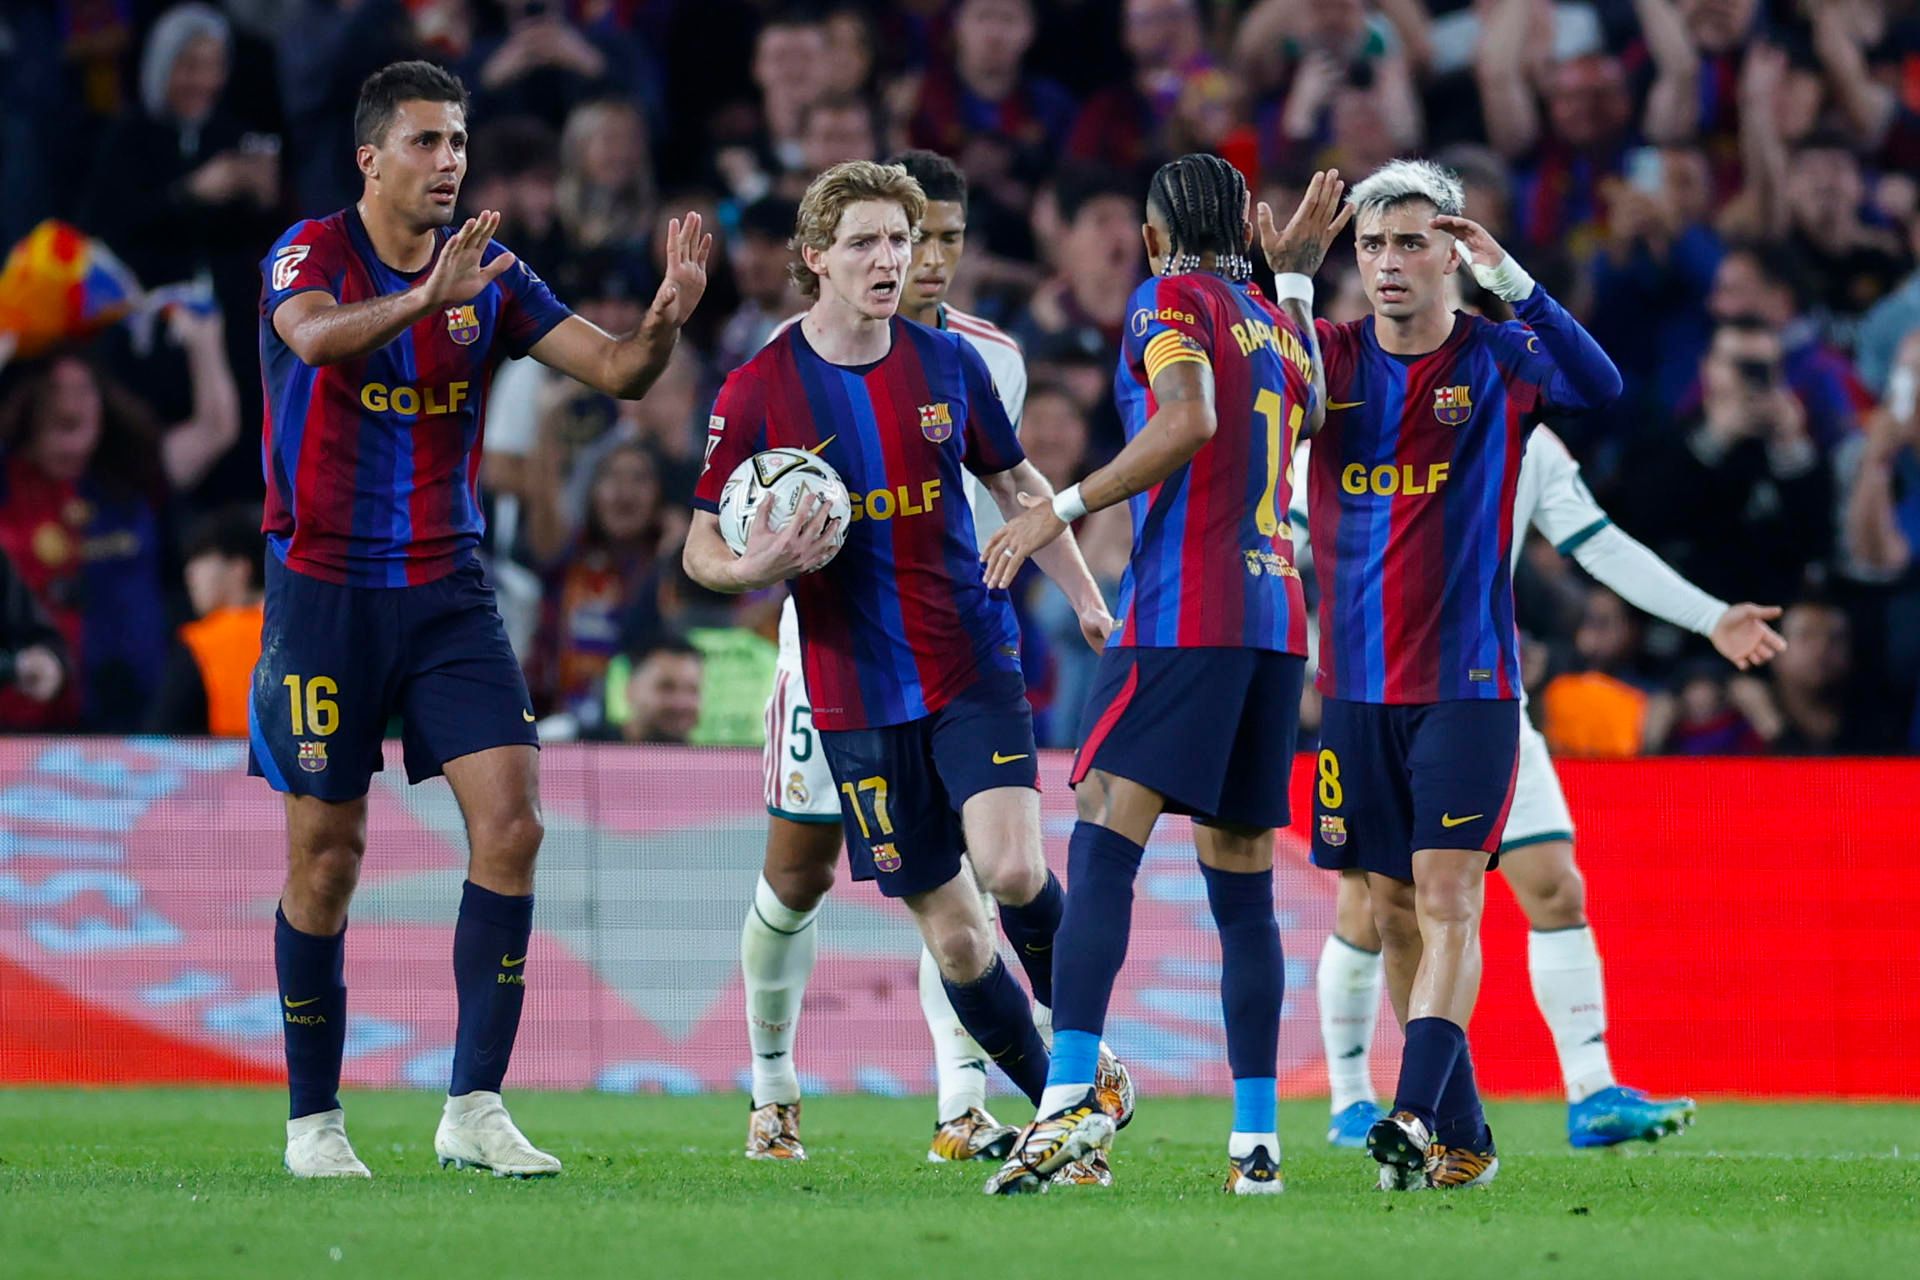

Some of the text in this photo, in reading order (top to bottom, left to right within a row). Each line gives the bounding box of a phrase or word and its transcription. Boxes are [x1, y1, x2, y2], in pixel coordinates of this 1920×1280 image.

[1131, 308, 1196, 337] Midea
[360, 381, 470, 416] GOLF
[849, 478, 942, 523] GOLF
[1341, 461, 1451, 497] GOLF
[282, 674, 340, 737] 16
[789, 705, 813, 763] 5
[1318, 748, 1344, 810] 8
[841, 775, 894, 839] 17
[285, 1011, 327, 1027] BARÇA
